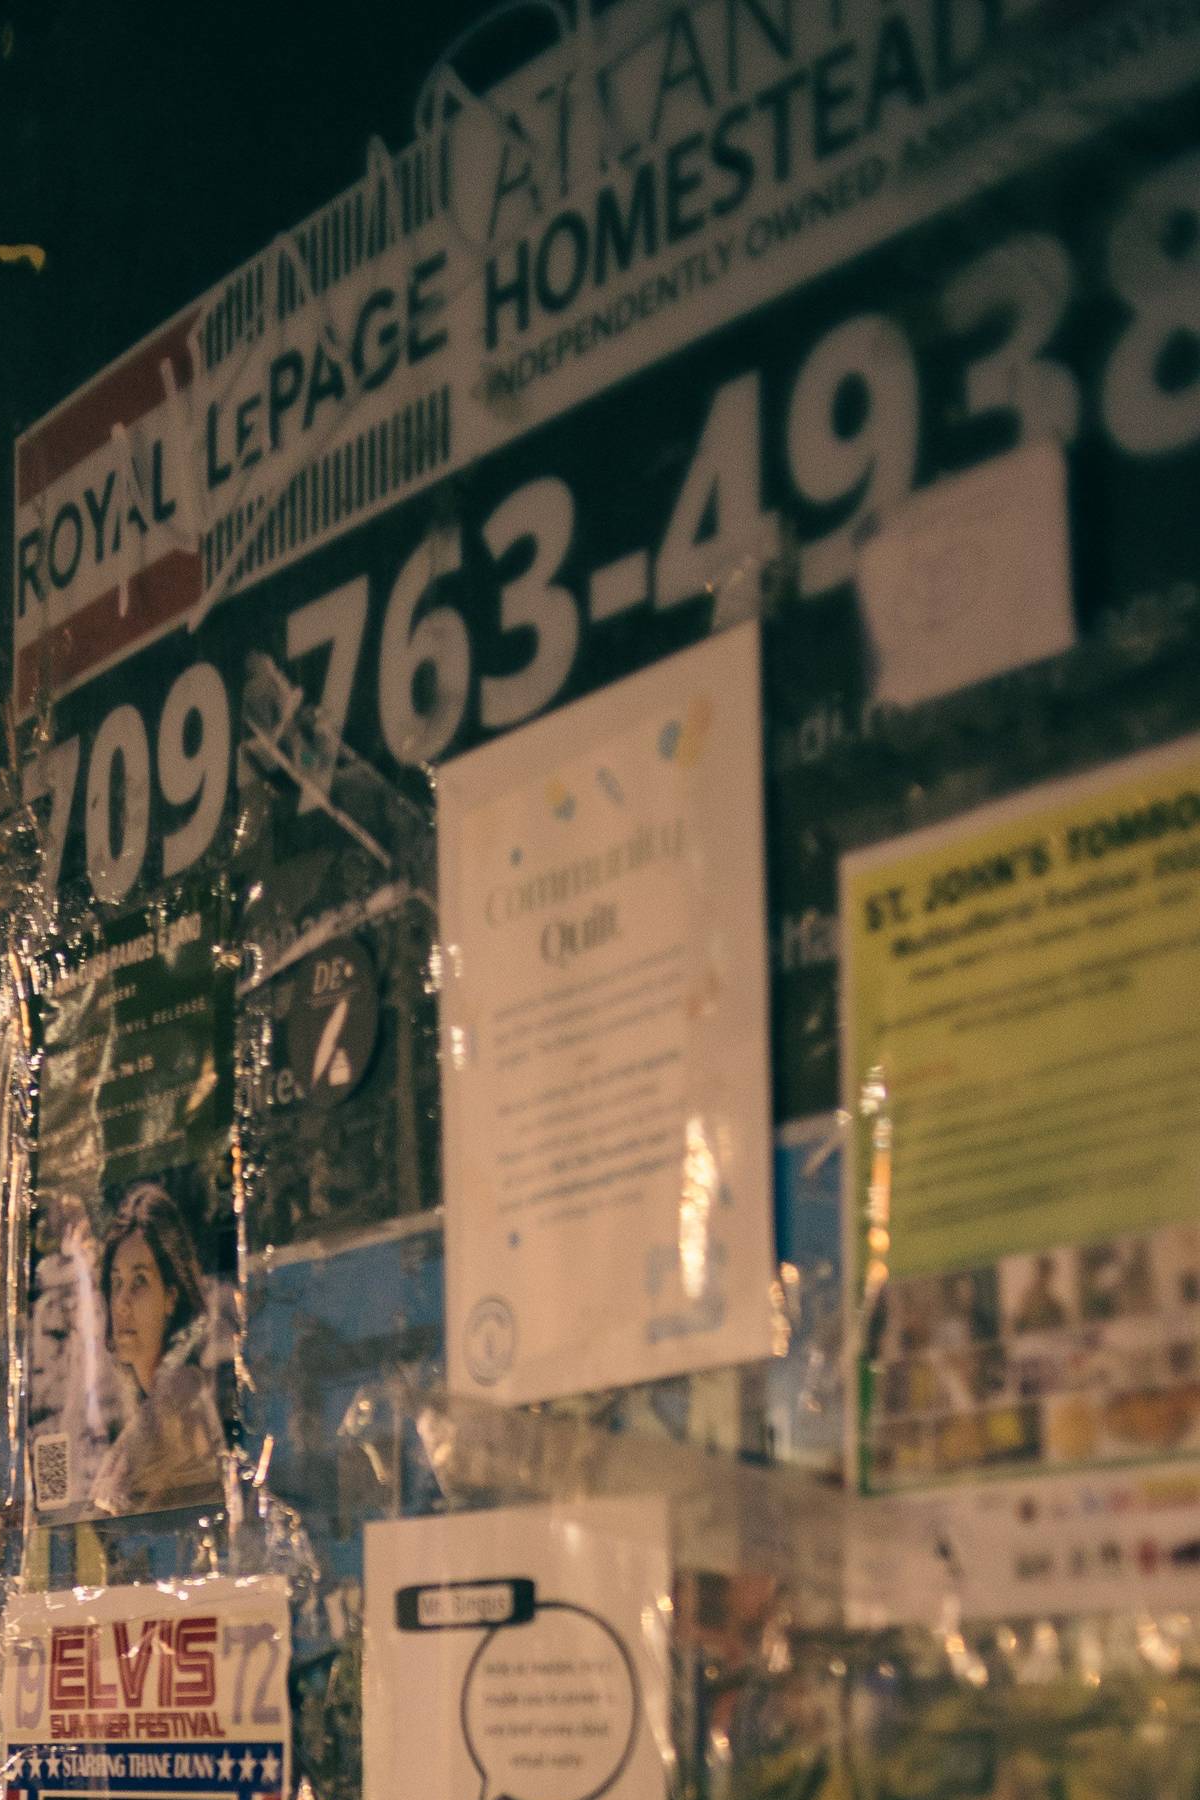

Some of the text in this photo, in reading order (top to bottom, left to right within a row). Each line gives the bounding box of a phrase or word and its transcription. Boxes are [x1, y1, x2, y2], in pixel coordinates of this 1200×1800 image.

[17, 434, 177, 618] ROYAL
[205, 250, 450, 490] LEPAGE
[483, 0, 991, 352] HOMESTEAD
[22, 660, 231, 908] 709
[48, 1617, 218, 1711] ELVIS
[222, 1621, 282, 1726] 72
[50, 1711, 227, 1739] SUMMER FESTIVAL
[62, 1753, 127, 1778] STARRING
